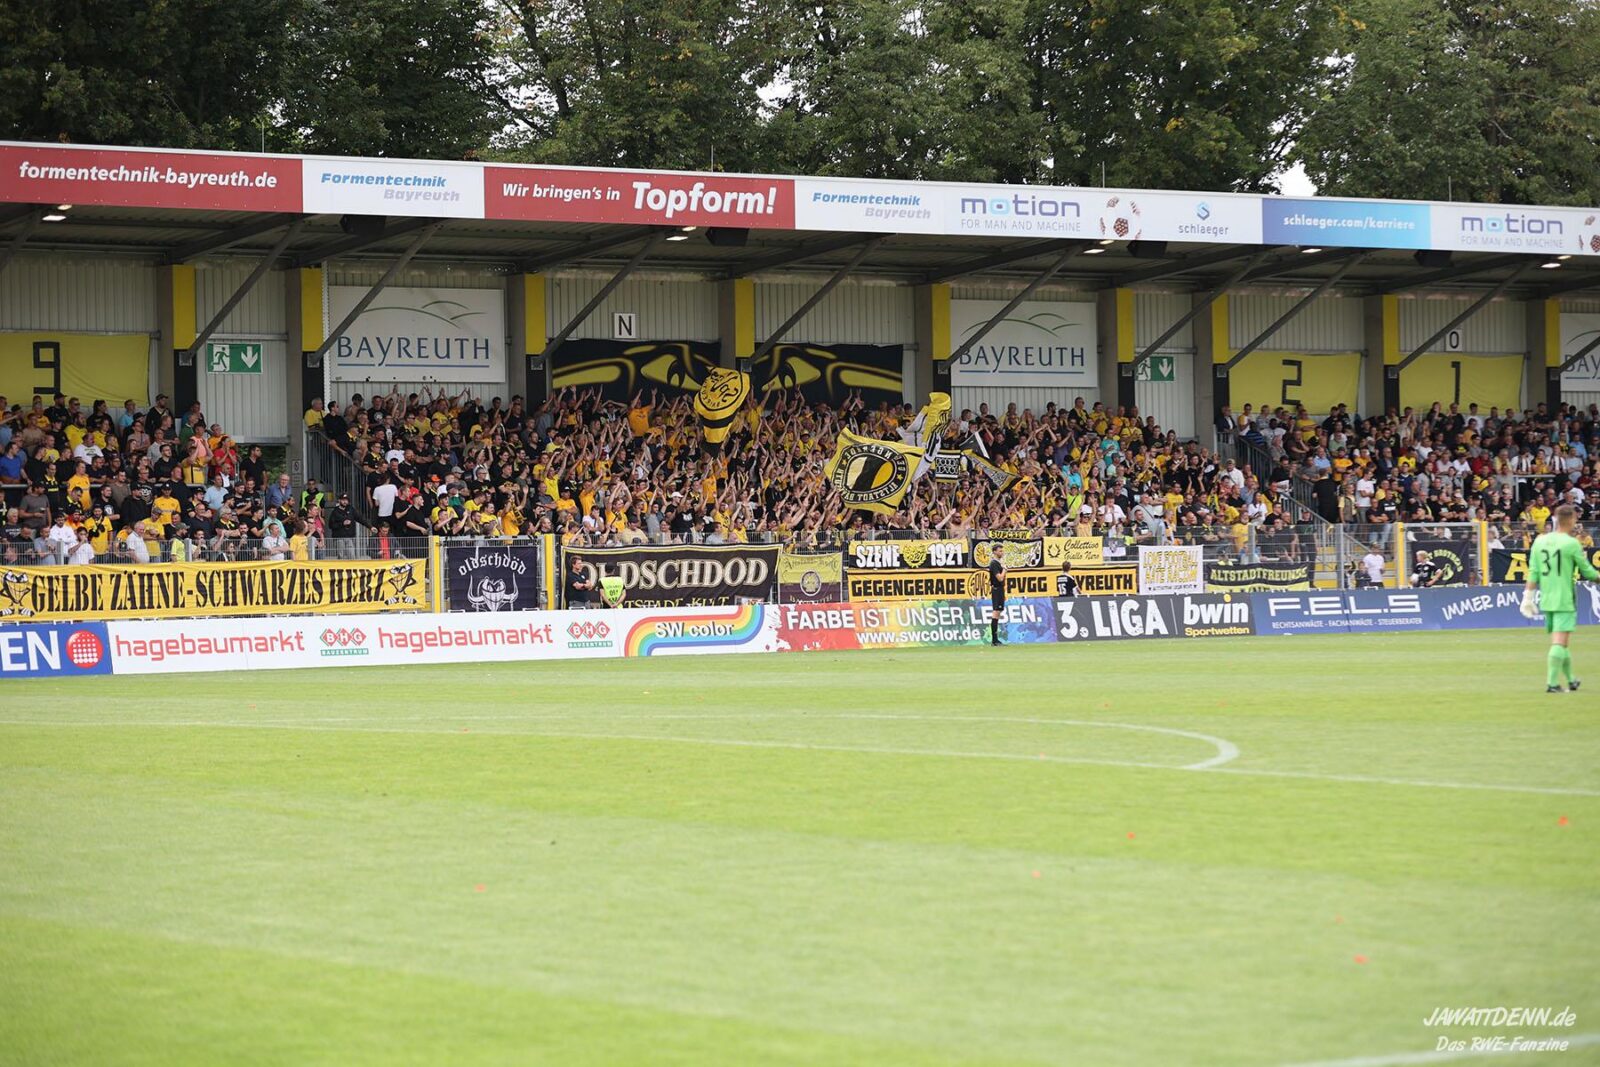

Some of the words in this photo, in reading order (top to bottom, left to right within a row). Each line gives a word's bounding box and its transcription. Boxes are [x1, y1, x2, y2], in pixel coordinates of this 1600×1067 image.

[19, 161, 278, 190] formentechnik-bayreuth.de
[320, 172, 446, 188] Formentechnik
[383, 188, 461, 203] Bayreuth
[502, 182, 529, 198] Wir
[605, 186, 621, 201] in
[632, 181, 777, 219] Topform!
[812, 191, 921, 207] Formentechnik
[961, 194, 1081, 218] motion
[864, 206, 932, 220] Bayreuth
[1283, 213, 1416, 231] schlaeger.com/karriere
[1461, 213, 1563, 235] motion
[961, 219, 981, 230] FOR
[984, 219, 1007, 231] MAN
[1011, 219, 1033, 231] AND
[1036, 220, 1081, 233] MACHINE
[1178, 223, 1229, 237] schlaeger
[1461, 236, 1478, 246] FOR
[1482, 237, 1501, 247] MAN
[1504, 237, 1522, 248] AND
[1525, 238, 1564, 249] MACHINE
[617, 313, 633, 338] N
[32, 341, 61, 396] 9
[1281, 359, 1302, 405] 2
[856, 544, 901, 568] SZENE
[927, 543, 963, 567] 1921
[1541, 549, 1561, 577] 31
[32, 574, 104, 612] GELBE
[329, 568, 386, 603] HERZ
[851, 577, 966, 597] GEGENGERADE
[1006, 576, 1048, 594] PVGG
[1057, 573, 1134, 592] YREUTH
[1183, 594, 1249, 625] bwin
[1268, 594, 1421, 617] F.E.L.S
[1442, 594, 1494, 621] IMMER
[1496, 591, 1521, 607] AM
[655, 621, 685, 639] SW
[689, 620, 734, 637] color
[787, 608, 856, 630] FARBE
[860, 608, 892, 628] IST
[897, 606, 965, 627] UNSER
[1056, 602, 1090, 639] 3.
[1091, 599, 1169, 637] LIGA
[324, 631, 364, 644] BHG
[378, 622, 553, 653] hagebaumarkt
[571, 624, 609, 637] BHG
[856, 626, 981, 644] www.swcolor.de
[1184, 627, 1250, 638] Sportwetten
[0, 630, 62, 672] EN
[115, 630, 305, 662] hagebaumarkt
